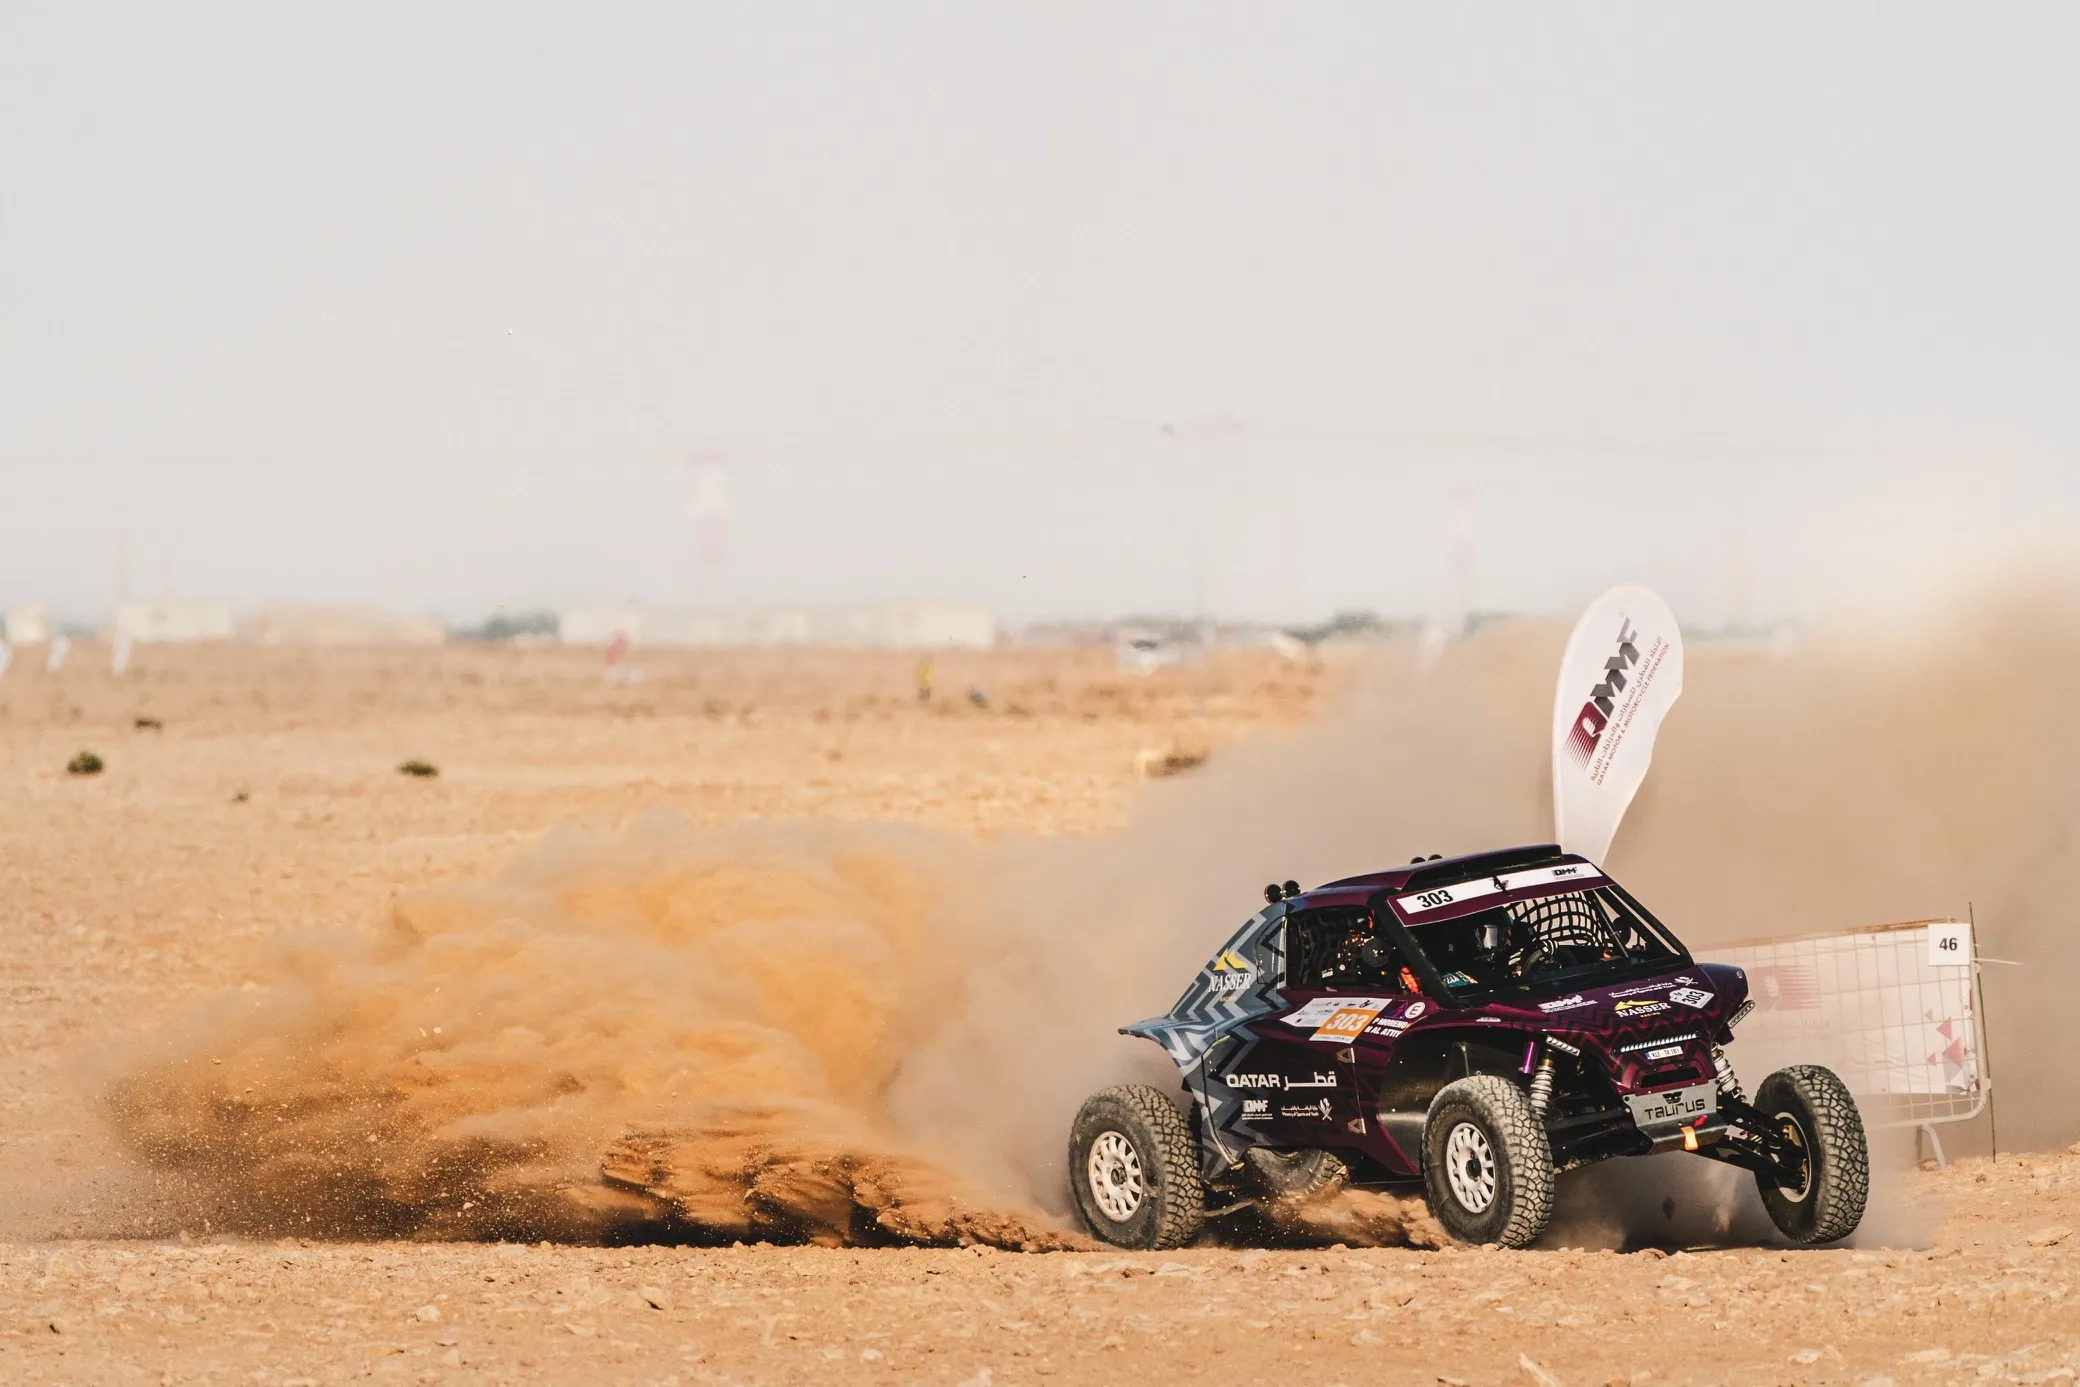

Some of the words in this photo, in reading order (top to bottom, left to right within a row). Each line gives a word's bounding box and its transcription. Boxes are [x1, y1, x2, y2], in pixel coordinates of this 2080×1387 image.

[1563, 617, 1640, 773] QMMF
[1597, 761, 1610, 785] QATAR
[1608, 735, 1622, 760] MOTOR
[1623, 681, 1650, 728] MOTORCYCLE
[1647, 643, 1670, 681] FEDERATION
[1416, 889, 1454, 908] 303
[1939, 937, 1958, 951] 46
[1208, 973, 1251, 992] NASSER
[1682, 990, 1705, 1004] 303
[1408, 1005, 1422, 1016] E
[1616, 1002, 1671, 1018] NASSER
[1326, 1013, 1370, 1031] 303
[1372, 1017, 1380, 1025] P
[1377, 1018, 1408, 1029] MORENO
[1370, 1026, 1382, 1035] AL
[1226, 1074, 1280, 1088] QATAR
[1284, 1071, 1337, 1091] قطر
